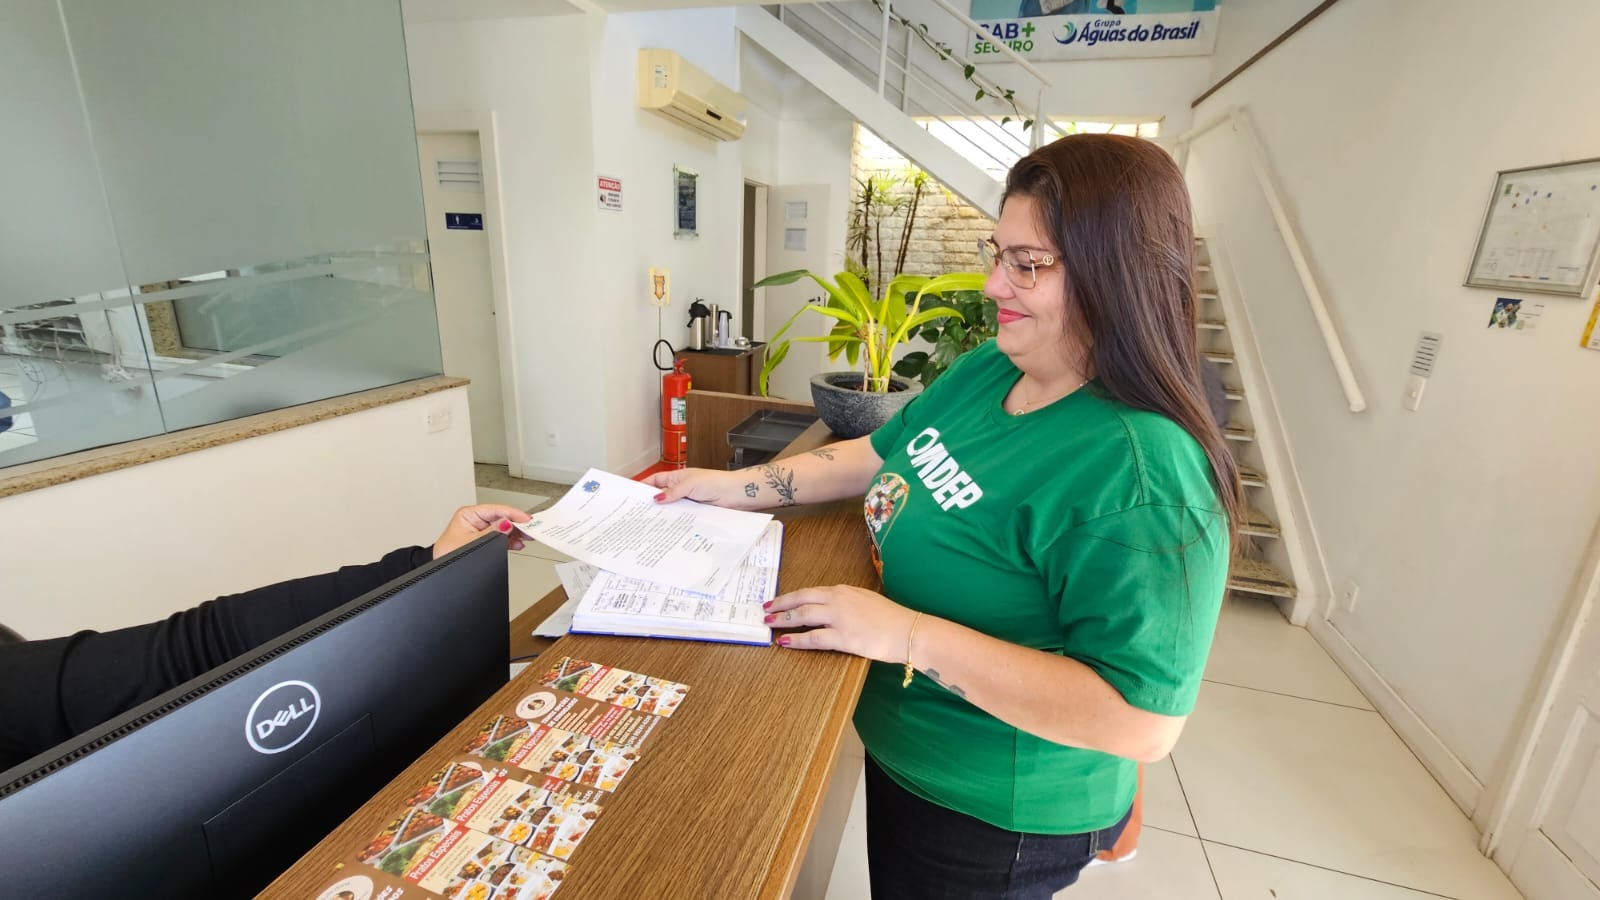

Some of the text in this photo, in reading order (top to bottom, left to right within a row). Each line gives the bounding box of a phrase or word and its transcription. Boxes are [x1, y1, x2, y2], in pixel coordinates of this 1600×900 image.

[1077, 20, 1200, 46] Águas do Brasil
[1094, 19, 1121, 30] Grupo
[256, 697, 315, 739] DELL
[521, 728, 547, 750] Especiais
[455, 801, 479, 824] Pratos
[471, 778, 501, 806] Especiais
[409, 856, 436, 880] Pratos
[427, 828, 463, 860] Especiais
